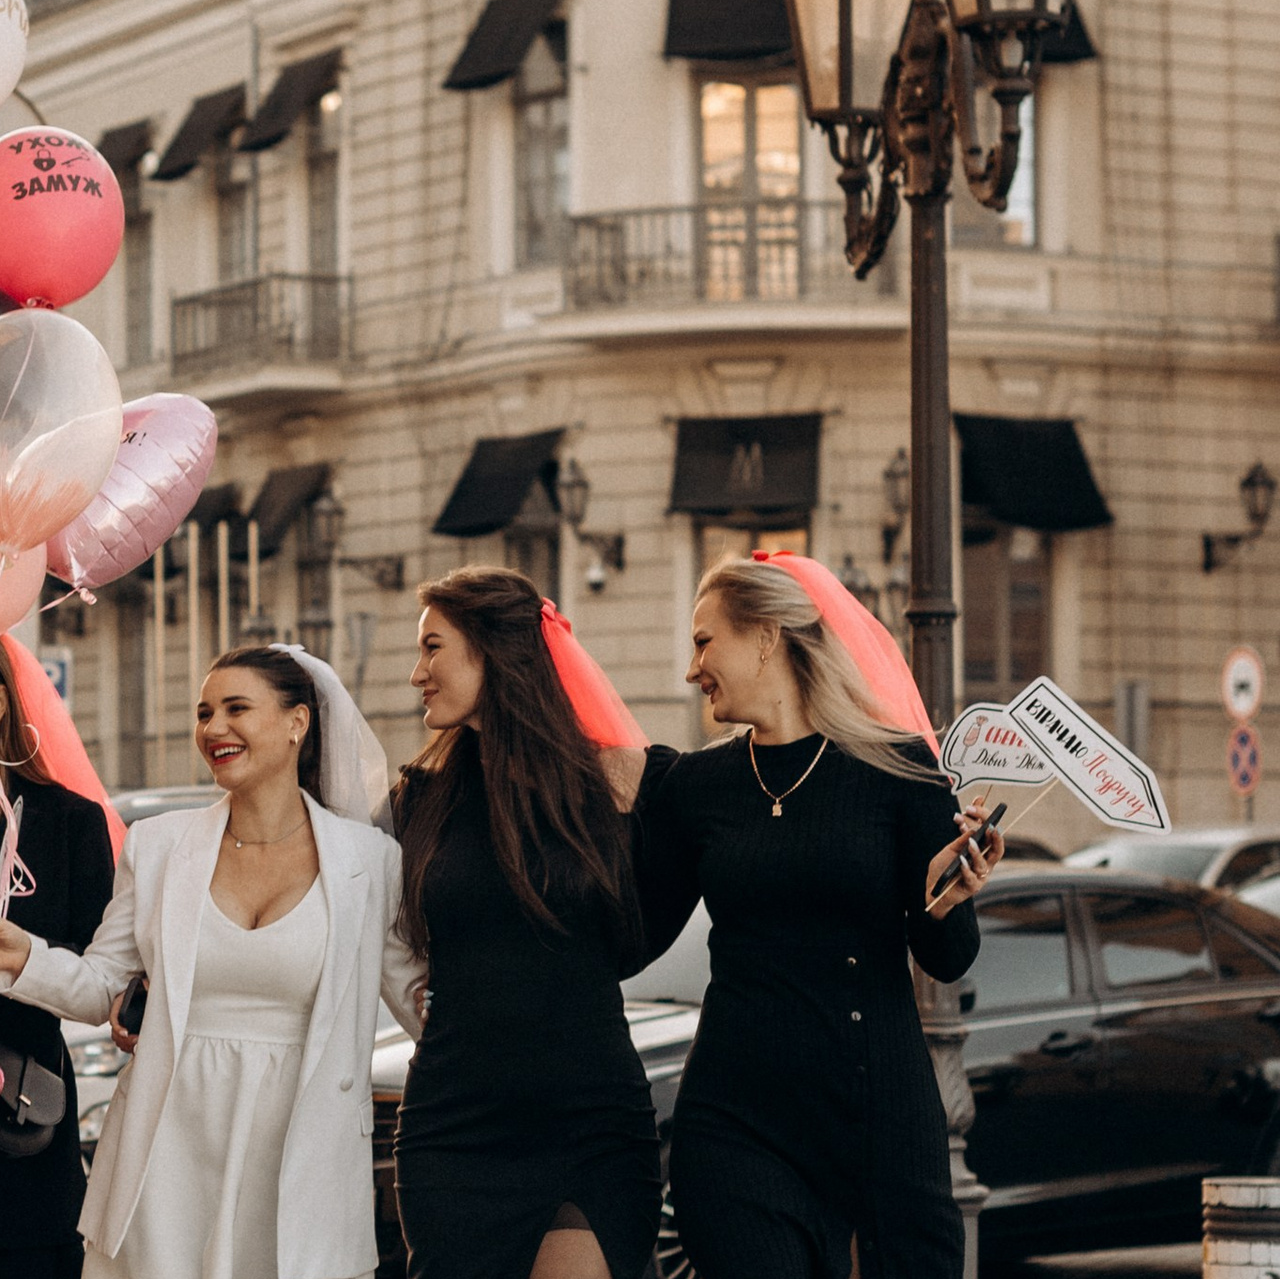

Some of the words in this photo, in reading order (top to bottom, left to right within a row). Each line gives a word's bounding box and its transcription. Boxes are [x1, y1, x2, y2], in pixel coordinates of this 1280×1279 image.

[11, 173, 103, 200] ЗАМУЖ
[1025, 698, 1089, 759] ВТРАЧАЮ
[1082, 749, 1155, 819] Подругу
